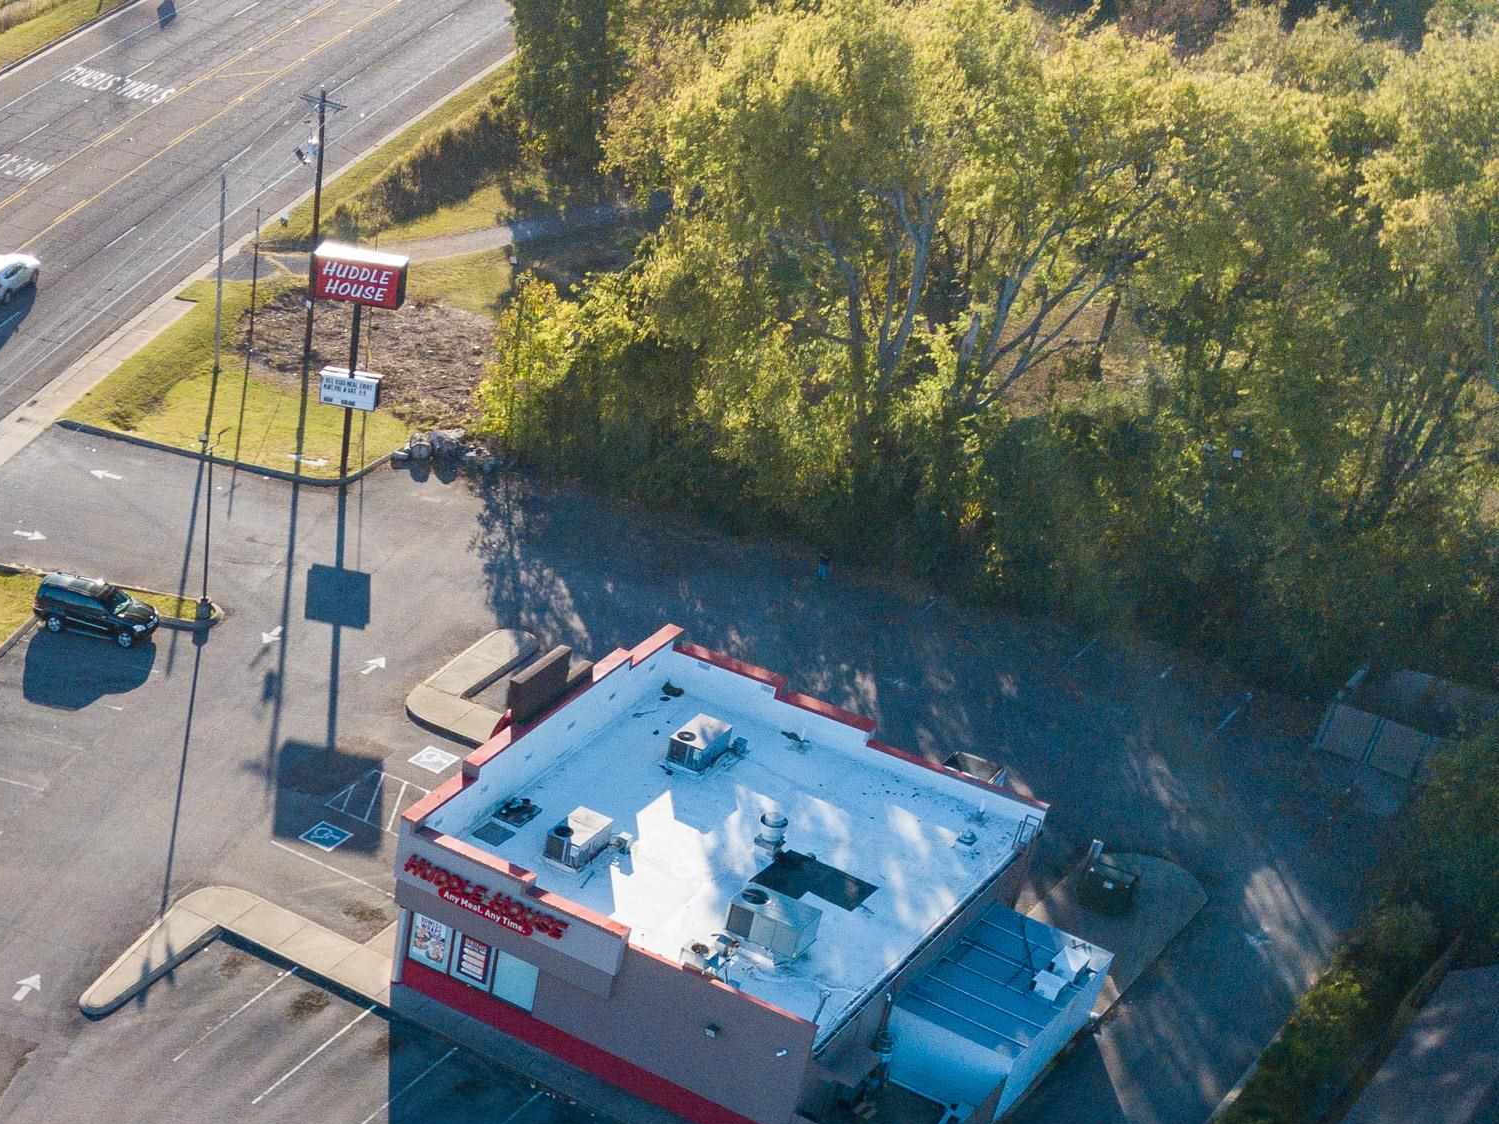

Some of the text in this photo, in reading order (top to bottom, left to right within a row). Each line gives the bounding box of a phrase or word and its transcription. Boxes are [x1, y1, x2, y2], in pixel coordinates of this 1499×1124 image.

[322, 260, 393, 285] HUDDLE
[323, 278, 388, 302] HOUSE
[443, 890, 461, 905] Any
[484, 909, 502, 924] Any
[502, 916, 527, 934] Time.
